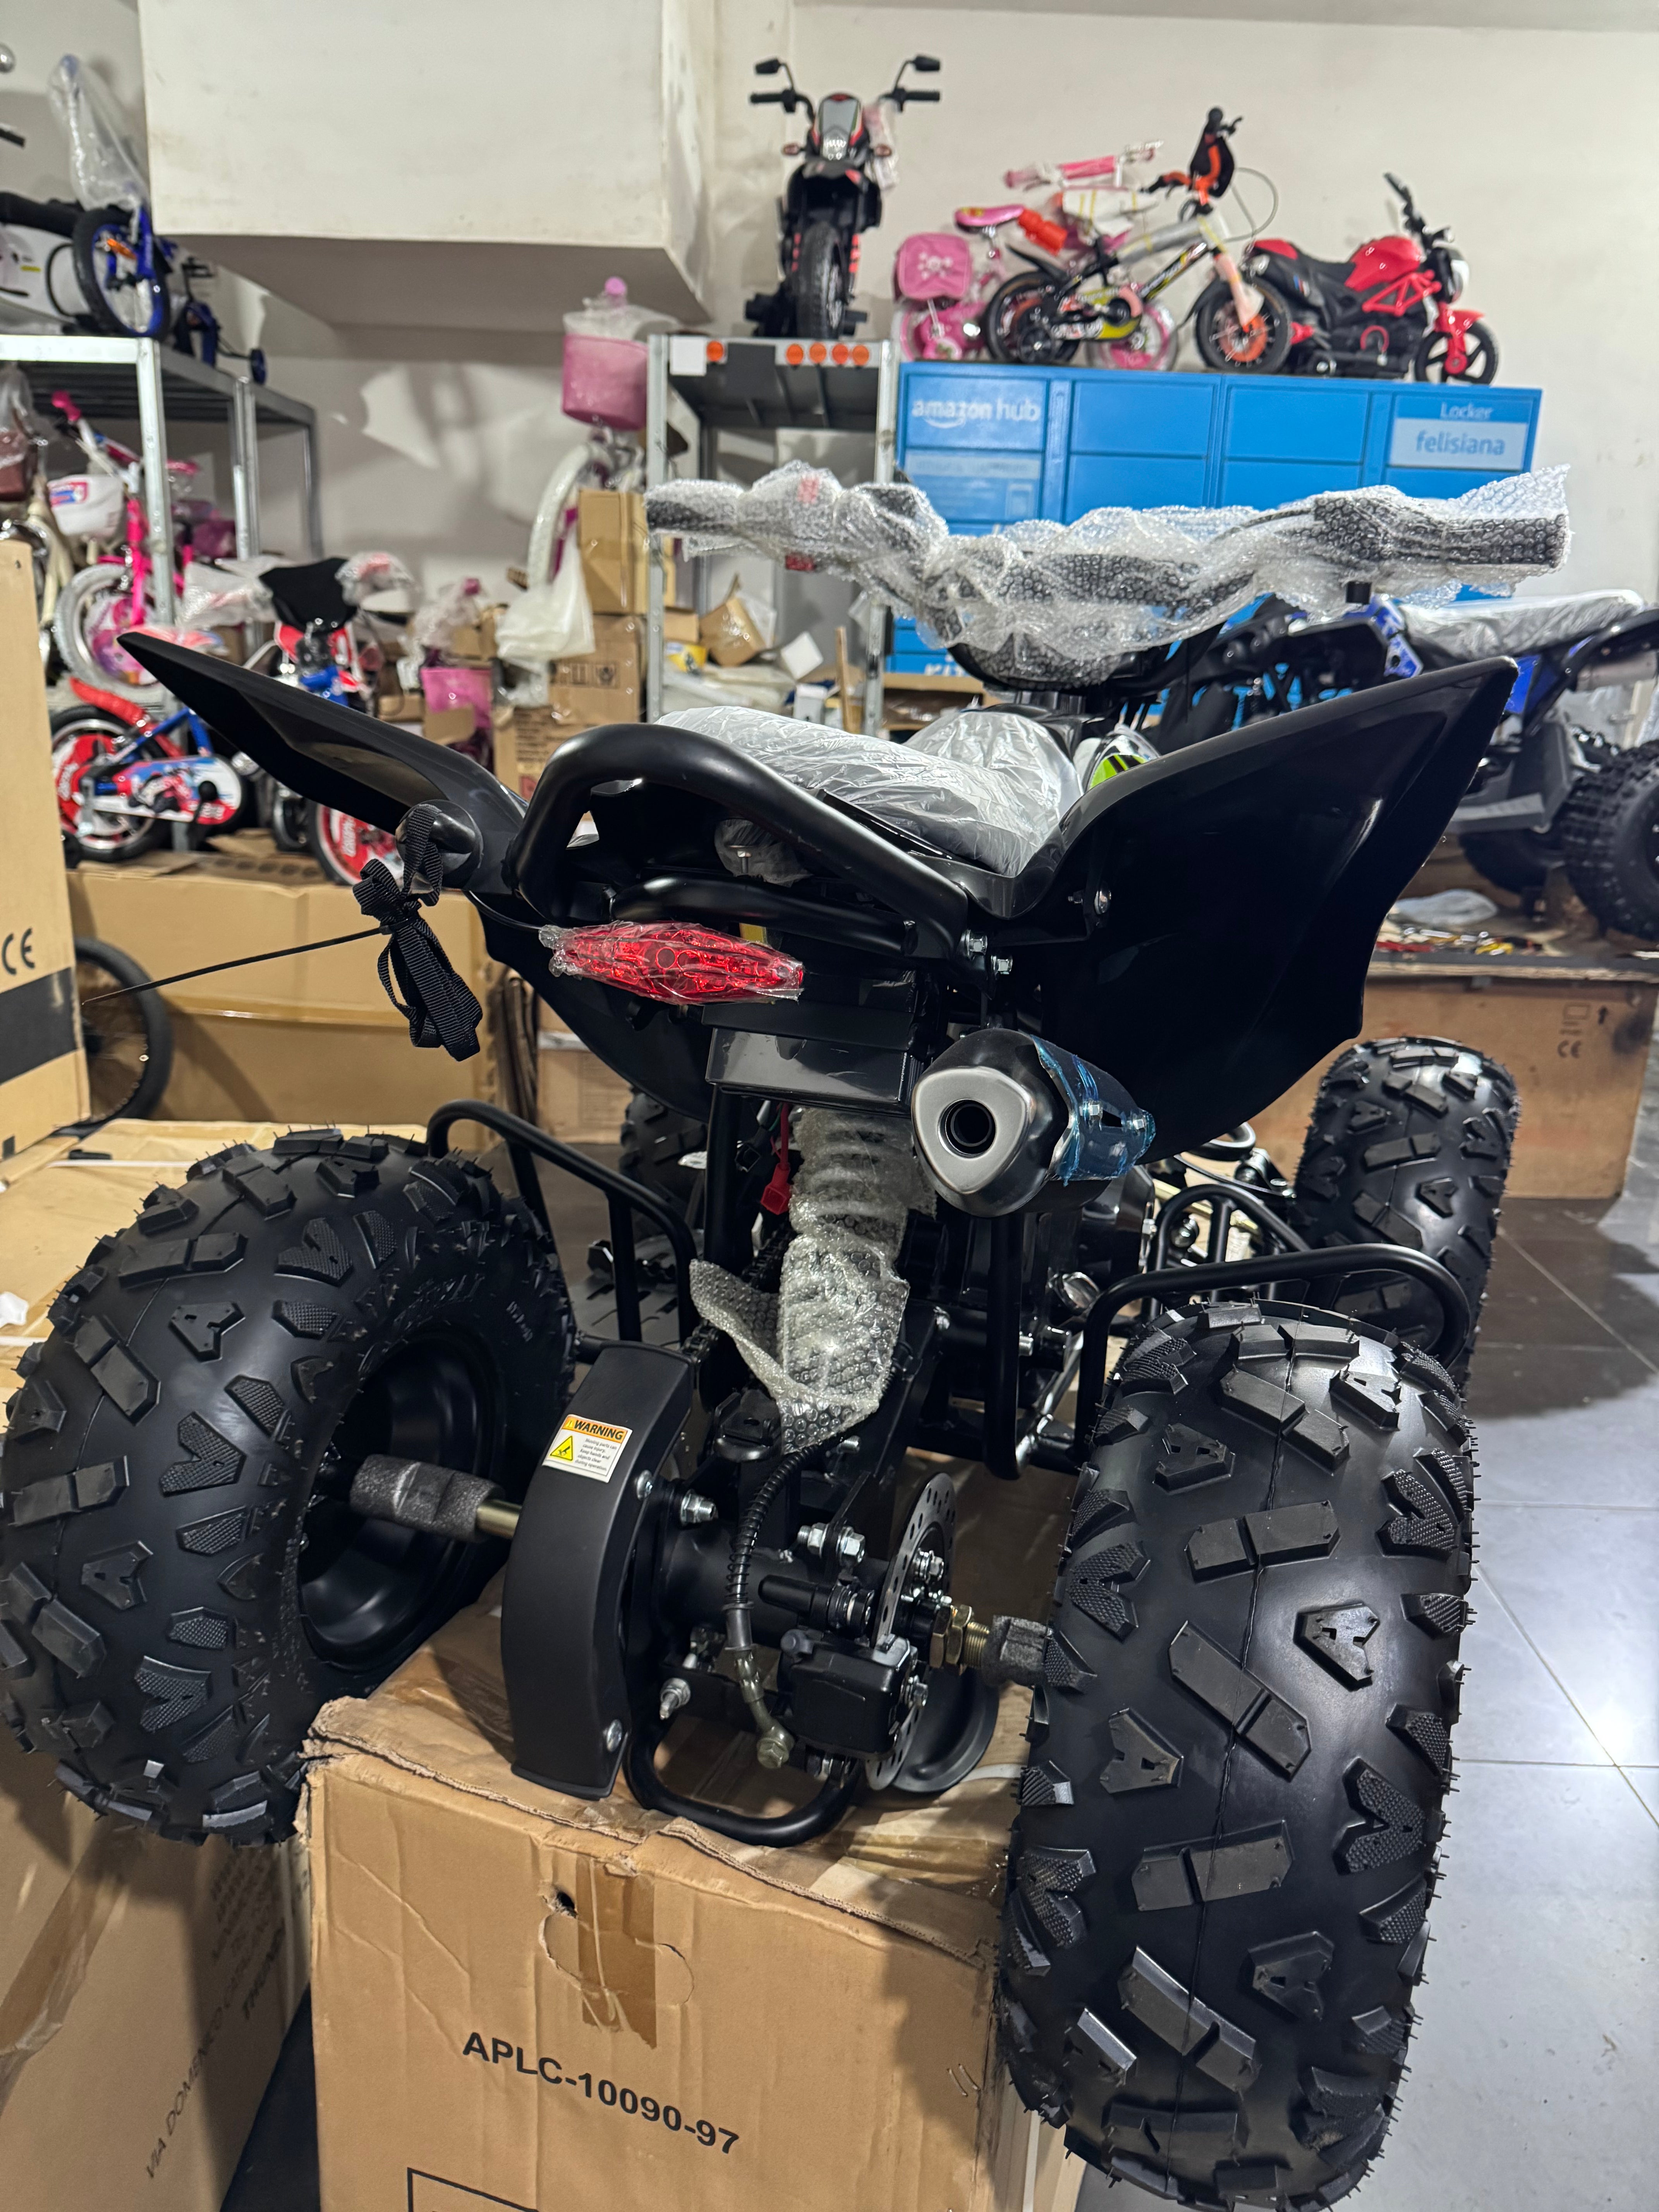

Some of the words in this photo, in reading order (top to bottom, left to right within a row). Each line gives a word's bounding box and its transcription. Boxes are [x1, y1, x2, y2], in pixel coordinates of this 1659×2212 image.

[912, 399, 992, 421] amazon
[996, 397, 1041, 421] hub
[1440, 402, 1493, 419] Locker
[1416, 429, 1506, 455] felisiana
[574, 1420, 624, 1440] WARNING
[463, 2032, 739, 2154] APLC-10090-97
